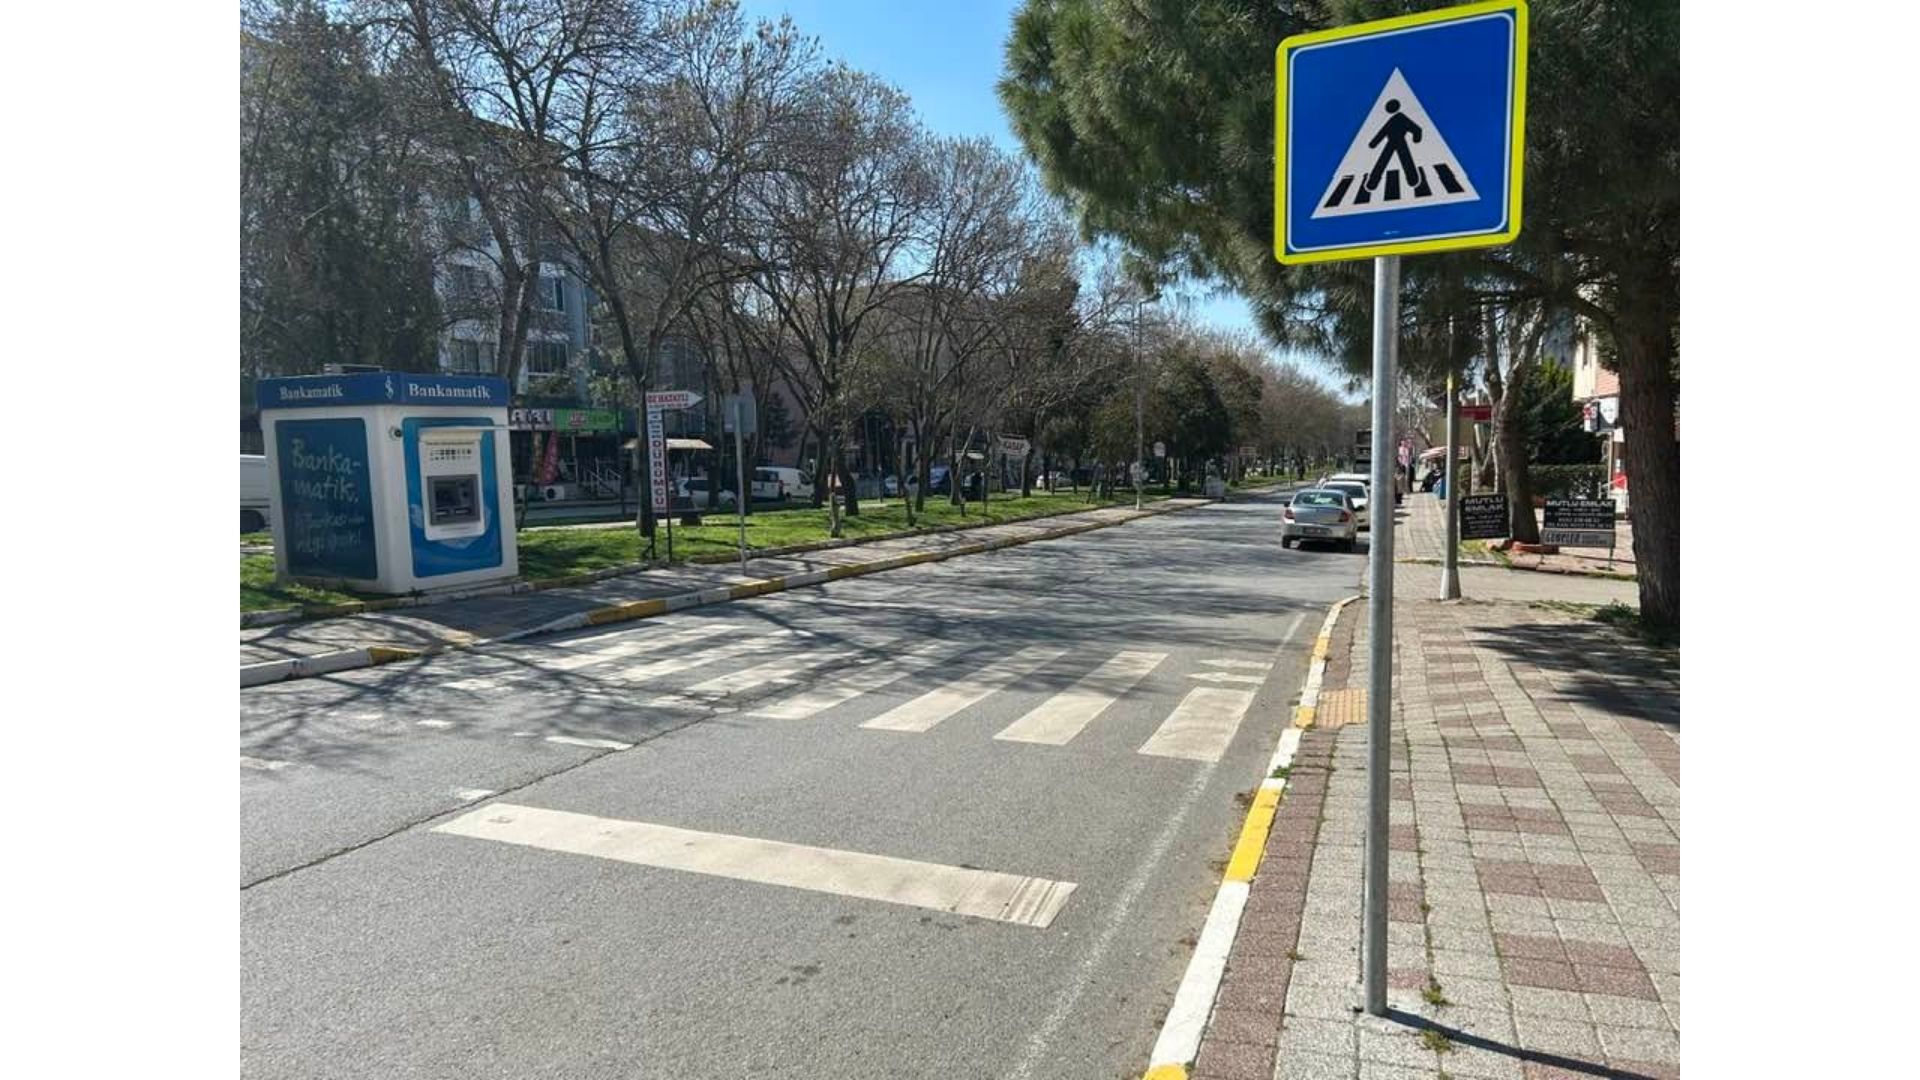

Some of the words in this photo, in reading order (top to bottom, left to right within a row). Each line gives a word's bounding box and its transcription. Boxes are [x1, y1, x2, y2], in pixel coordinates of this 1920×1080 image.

[280, 384, 344, 400] Bankamatik
[408, 383, 491, 399] Bankamatik
[1465, 496, 1504, 505] MUTLU
[1580, 500, 1614, 508] EMLAK
[1465, 503, 1504, 512] EMLAK
